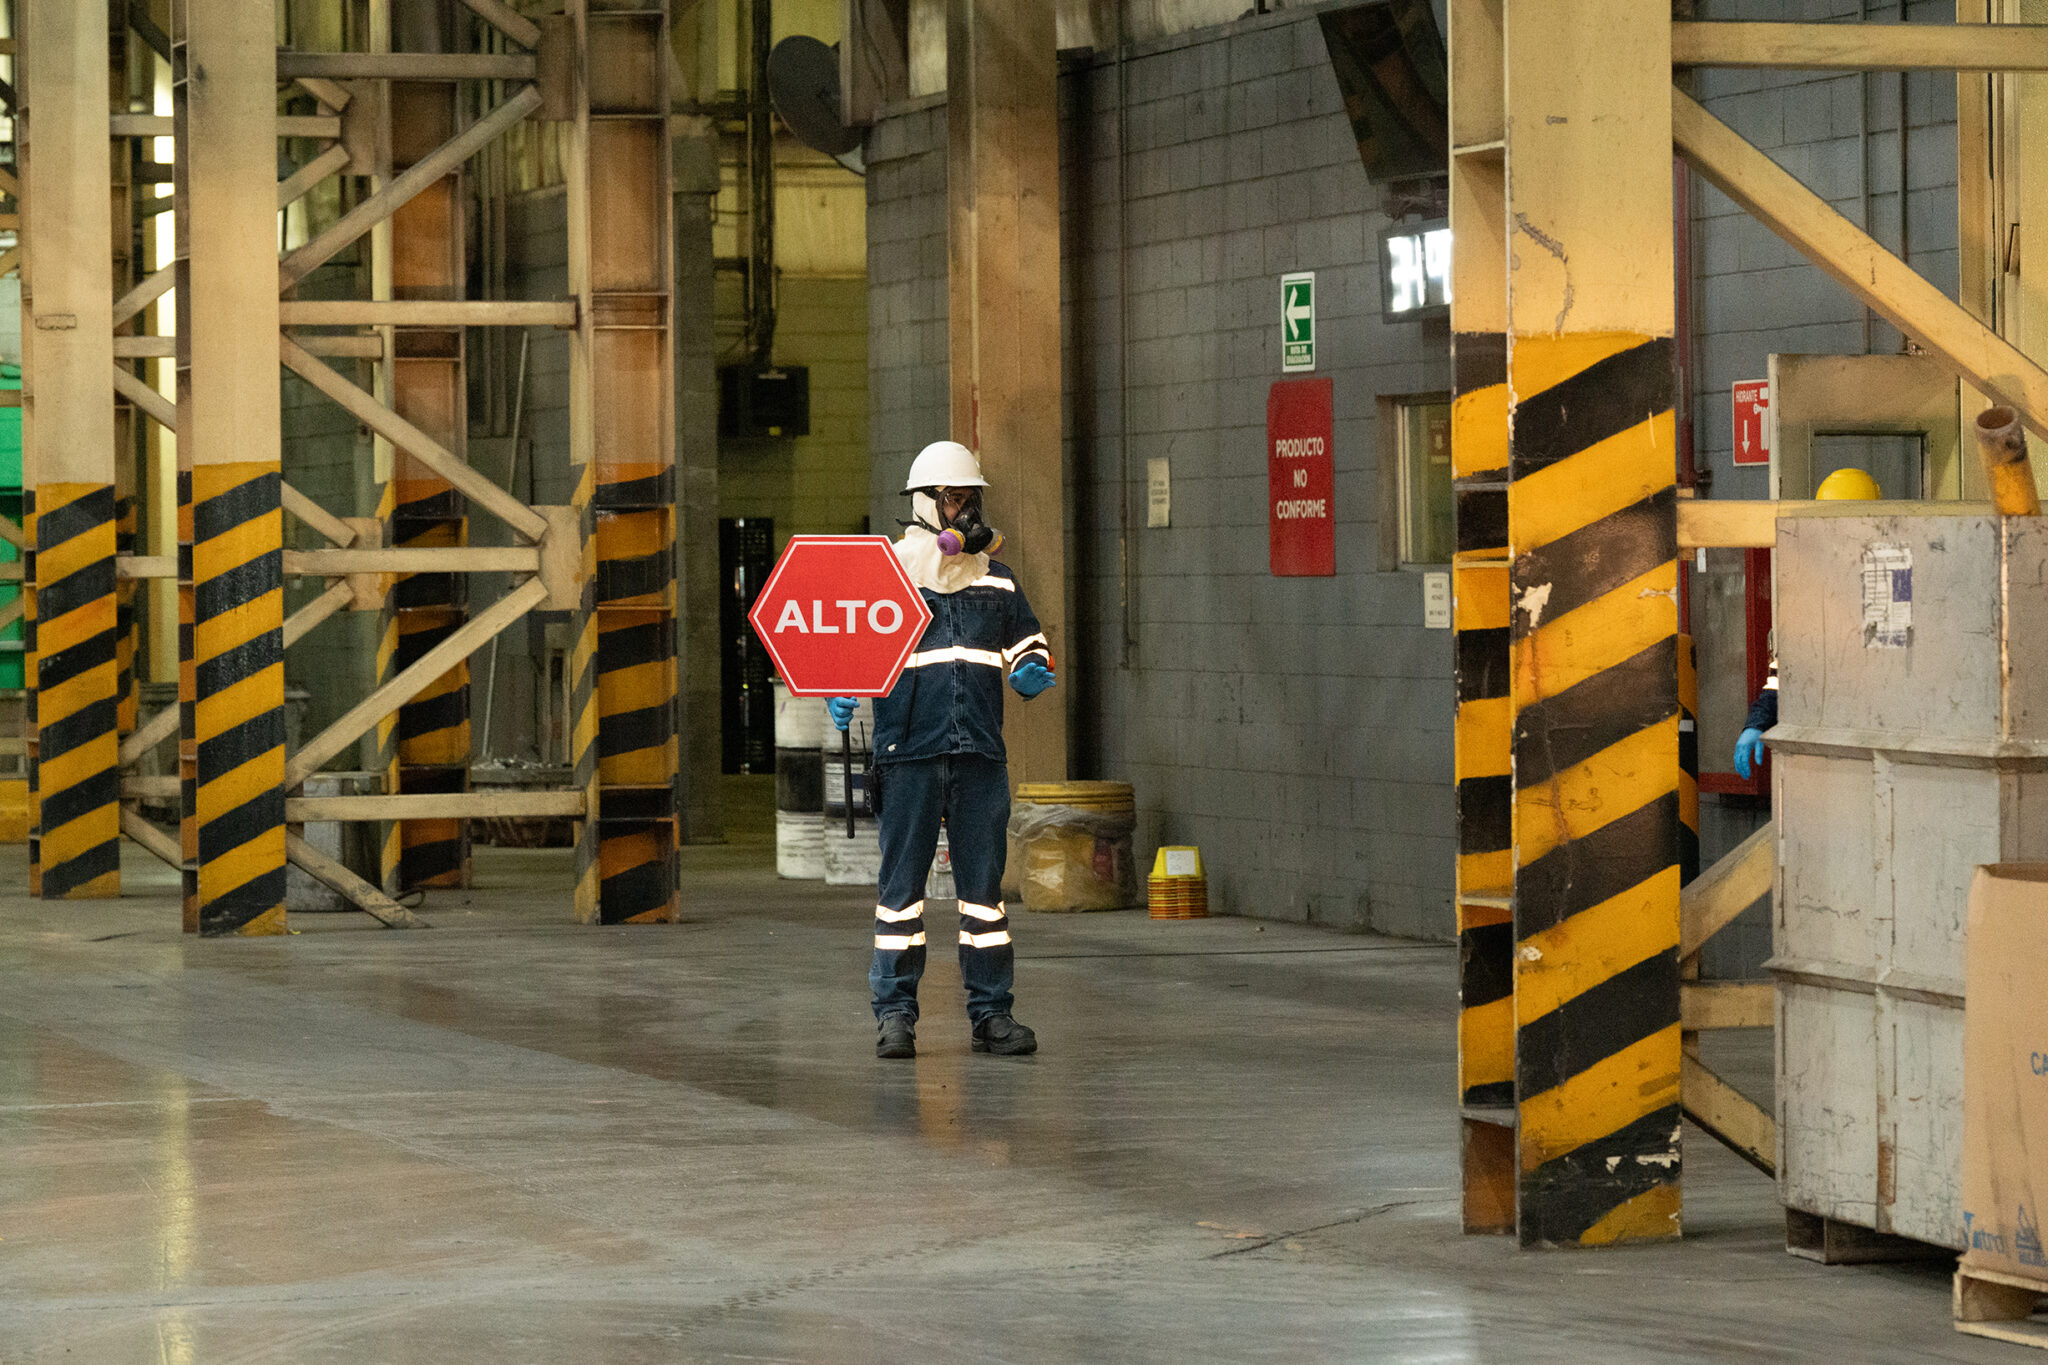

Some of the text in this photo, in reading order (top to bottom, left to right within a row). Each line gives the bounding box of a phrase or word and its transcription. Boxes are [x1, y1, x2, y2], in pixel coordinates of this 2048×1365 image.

[1275, 437, 1325, 458] PRODUCTO
[1293, 468, 1308, 488] NO
[1276, 499, 1327, 519] CONFORME
[773, 599, 904, 634] ALTO
